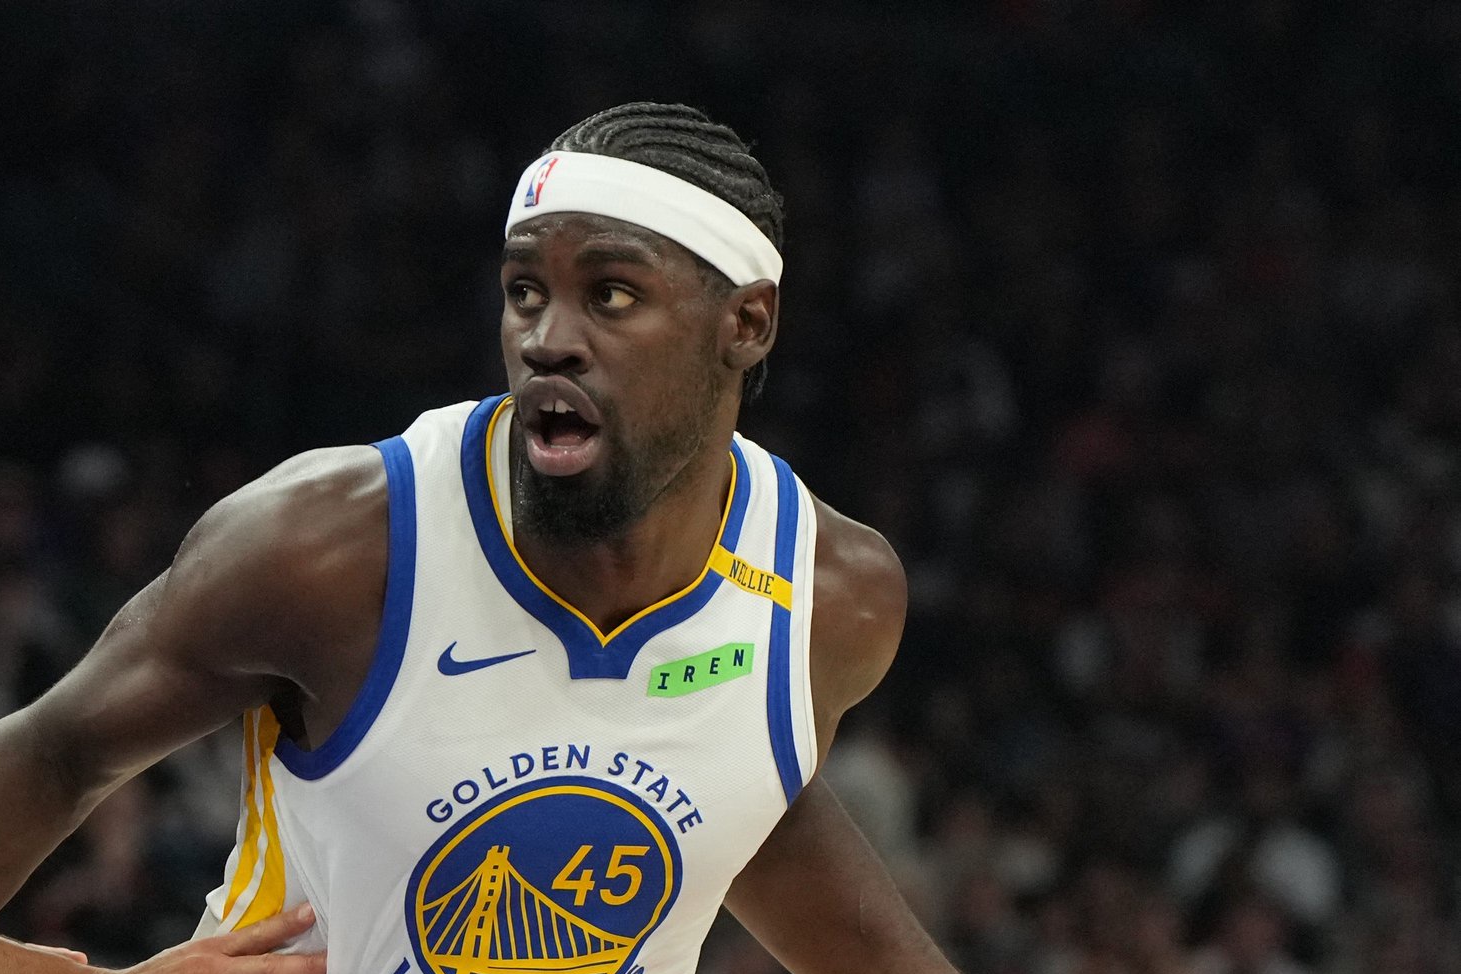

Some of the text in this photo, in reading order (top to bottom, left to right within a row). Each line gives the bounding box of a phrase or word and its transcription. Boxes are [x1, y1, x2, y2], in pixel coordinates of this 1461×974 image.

[729, 558, 775, 596] NELLIE
[657, 648, 745, 690] IREN
[426, 744, 703, 834] GOLDEN STATE
[551, 845, 650, 906] 45
